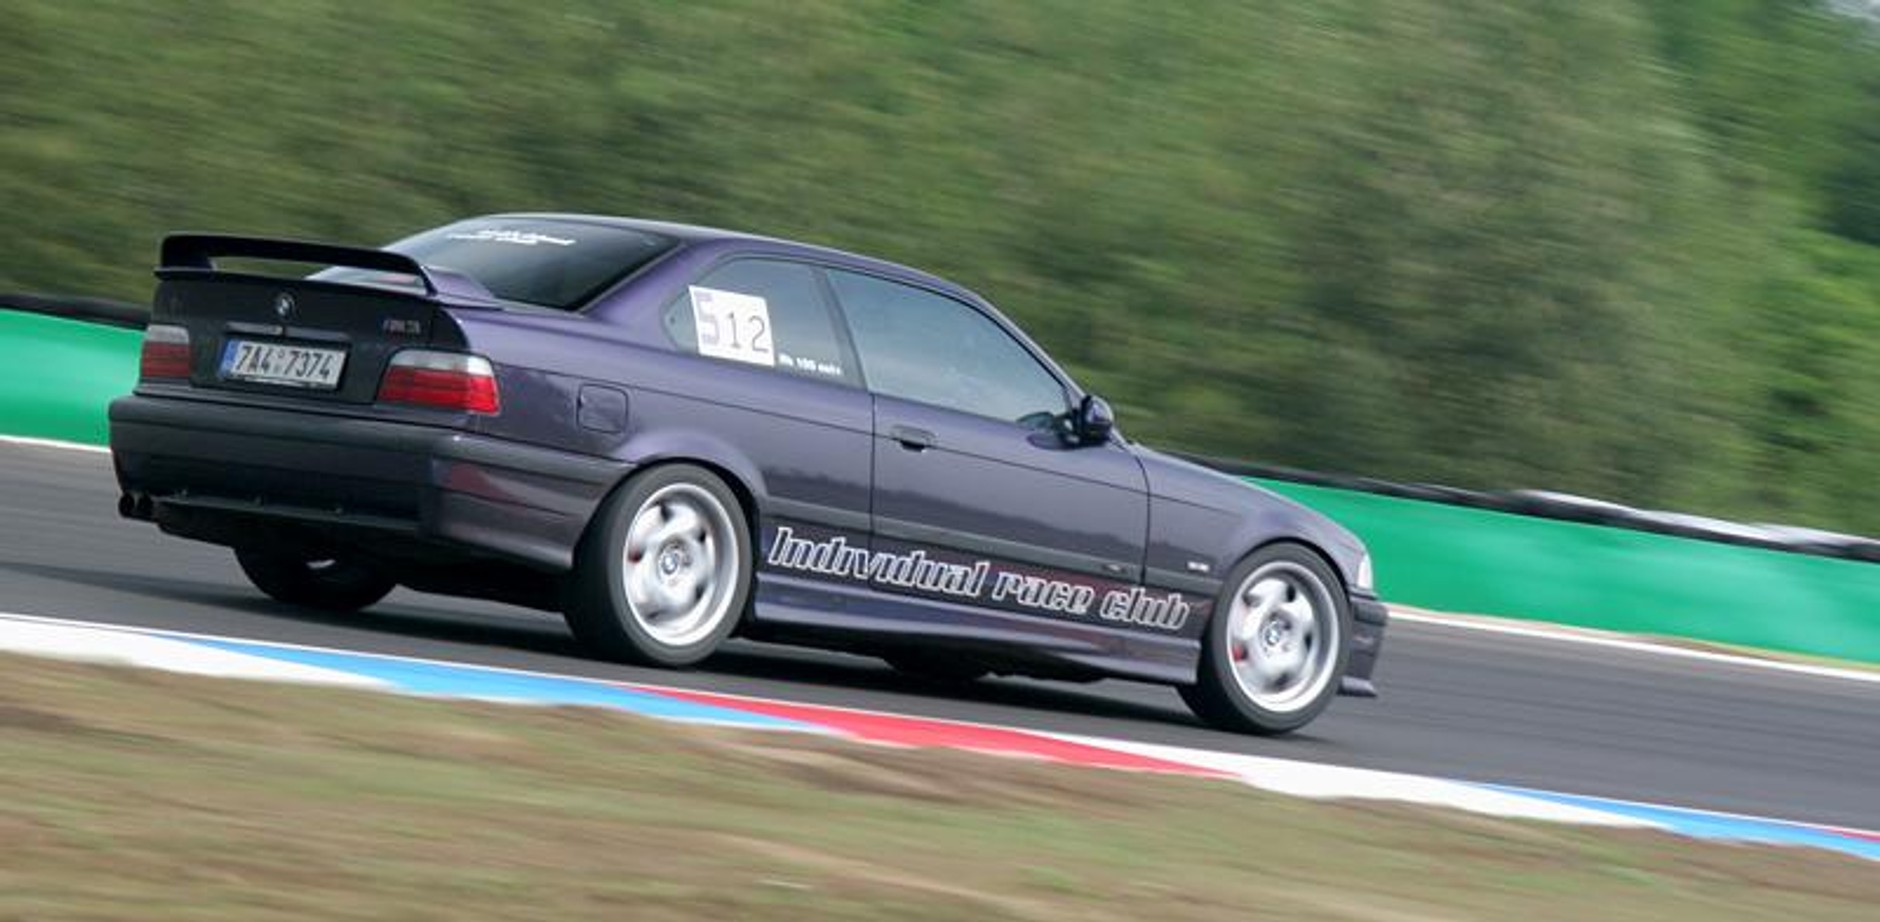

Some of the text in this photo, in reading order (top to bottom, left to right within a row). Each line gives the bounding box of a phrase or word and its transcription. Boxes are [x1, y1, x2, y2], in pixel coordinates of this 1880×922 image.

[694, 290, 769, 353] 512
[284, 349, 333, 379] 7374
[768, 526, 1191, 630] Individual race club
